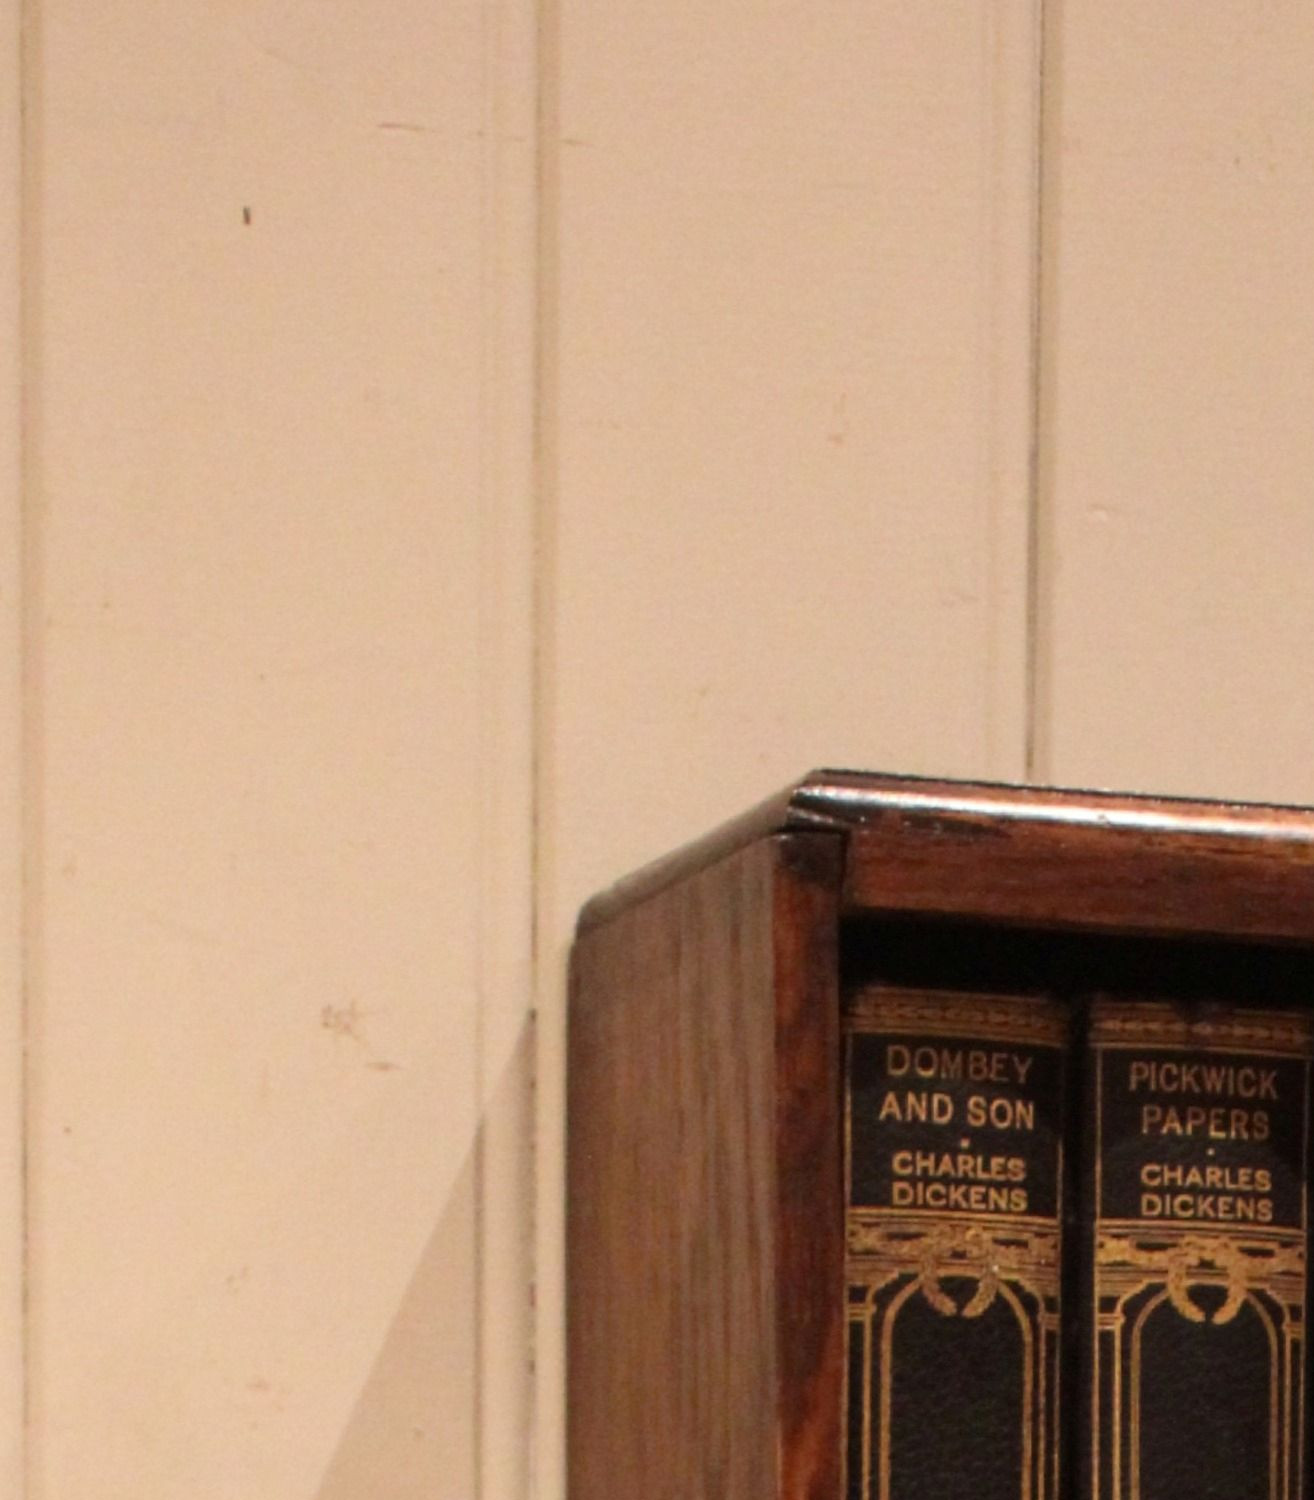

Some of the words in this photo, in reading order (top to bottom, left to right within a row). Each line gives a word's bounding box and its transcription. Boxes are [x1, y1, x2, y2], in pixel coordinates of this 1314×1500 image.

[886, 1045, 1033, 1084] DOMBEY
[1129, 1062, 1278, 1099] PICKWICK
[879, 1092, 954, 1123] AND
[967, 1096, 1035, 1130] SON
[1142, 1106, 1270, 1141] PAPERS
[892, 1151, 1026, 1182] CHARLES
[1141, 1163, 1272, 1192] CHARLES
[892, 1181, 1028, 1212] DICKENS
[1141, 1194, 1273, 1222] DICKENS
